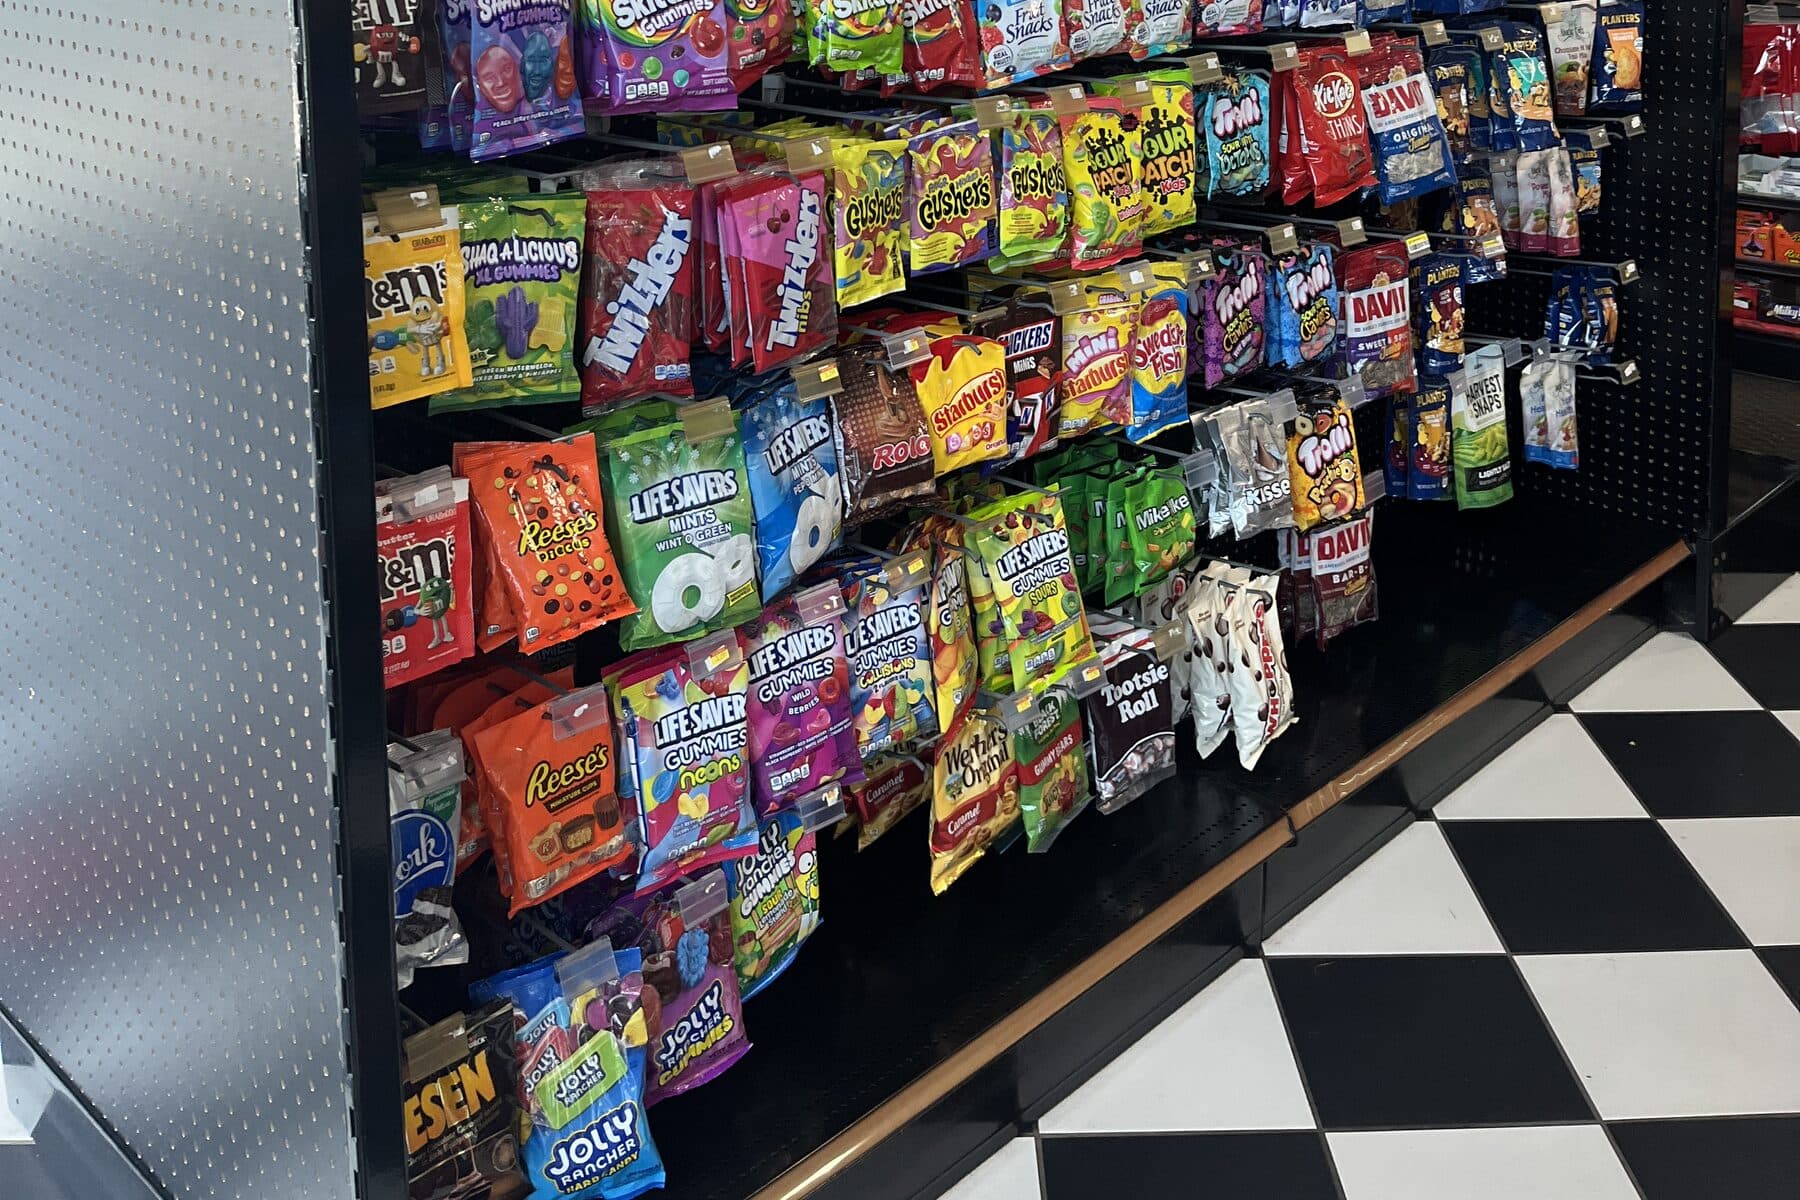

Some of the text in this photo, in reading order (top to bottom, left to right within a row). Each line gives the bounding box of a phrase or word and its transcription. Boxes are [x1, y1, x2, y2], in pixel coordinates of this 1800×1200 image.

[501, 7, 563, 28] XL GUMMIES
[1006, 16, 1053, 46] Snacks
[1084, 5, 1121, 30] Snacks
[1601, 13, 1641, 26] PLANTERS
[993, 51, 1008, 60] REAL
[1074, 36, 1088, 45] REAL
[1088, 143, 1127, 172] SOUR
[1142, 126, 1188, 160] OUR
[1222, 140, 1240, 154] SOUR
[1011, 160, 1067, 201] Gushers
[1160, 177, 1187, 195] Kids
[845, 183, 904, 238] Gushers
[919, 175, 991, 231] Gushers
[476, 263, 561, 286] XL GUMMIES
[1215, 261, 1259, 325] Trolli
[1358, 339, 1386, 351] SWEET
[1150, 349, 1182, 380] Fish
[934, 368, 1005, 436] Starburst
[1465, 374, 1503, 402] HARVEST
[1472, 393, 1502, 418] SNAPS
[1298, 414, 1352, 476] Trolli
[790, 455, 819, 481] MINTS
[518, 509, 598, 557] Reese's
[669, 508, 716, 534] MINTS
[1135, 506, 1170, 532] Mike
[656, 523, 733, 552] WINT O GREEN
[1012, 558, 1070, 598] GUMMIES
[1029, 580, 1058, 606] SOURS
[855, 636, 917, 676] GUMMIES
[758, 658, 834, 703] GUMMIES
[791, 688, 811, 703] WILD
[1101, 663, 1169, 707] Tootsie
[788, 696, 820, 715] BERRIES
[1117, 688, 1160, 724] Roll
[665, 728, 747, 772] GUMMIES
[525, 746, 608, 808] Reese's
[680, 754, 741, 790] neons
[947, 801, 982, 835] Caramel
[761, 888, 784, 915] SOUR
[526, 1011, 557, 1044] JOLLY
[659, 985, 720, 1061] JOLLY
[525, 1046, 556, 1094] JOLLY
[556, 1054, 601, 1098] JOLLY
[404, 1050, 497, 1155] ESEN
[563, 1071, 605, 1106] RANCHER
[550, 1108, 635, 1176] JOLLY
[561, 1138, 637, 1187] RANCHER
